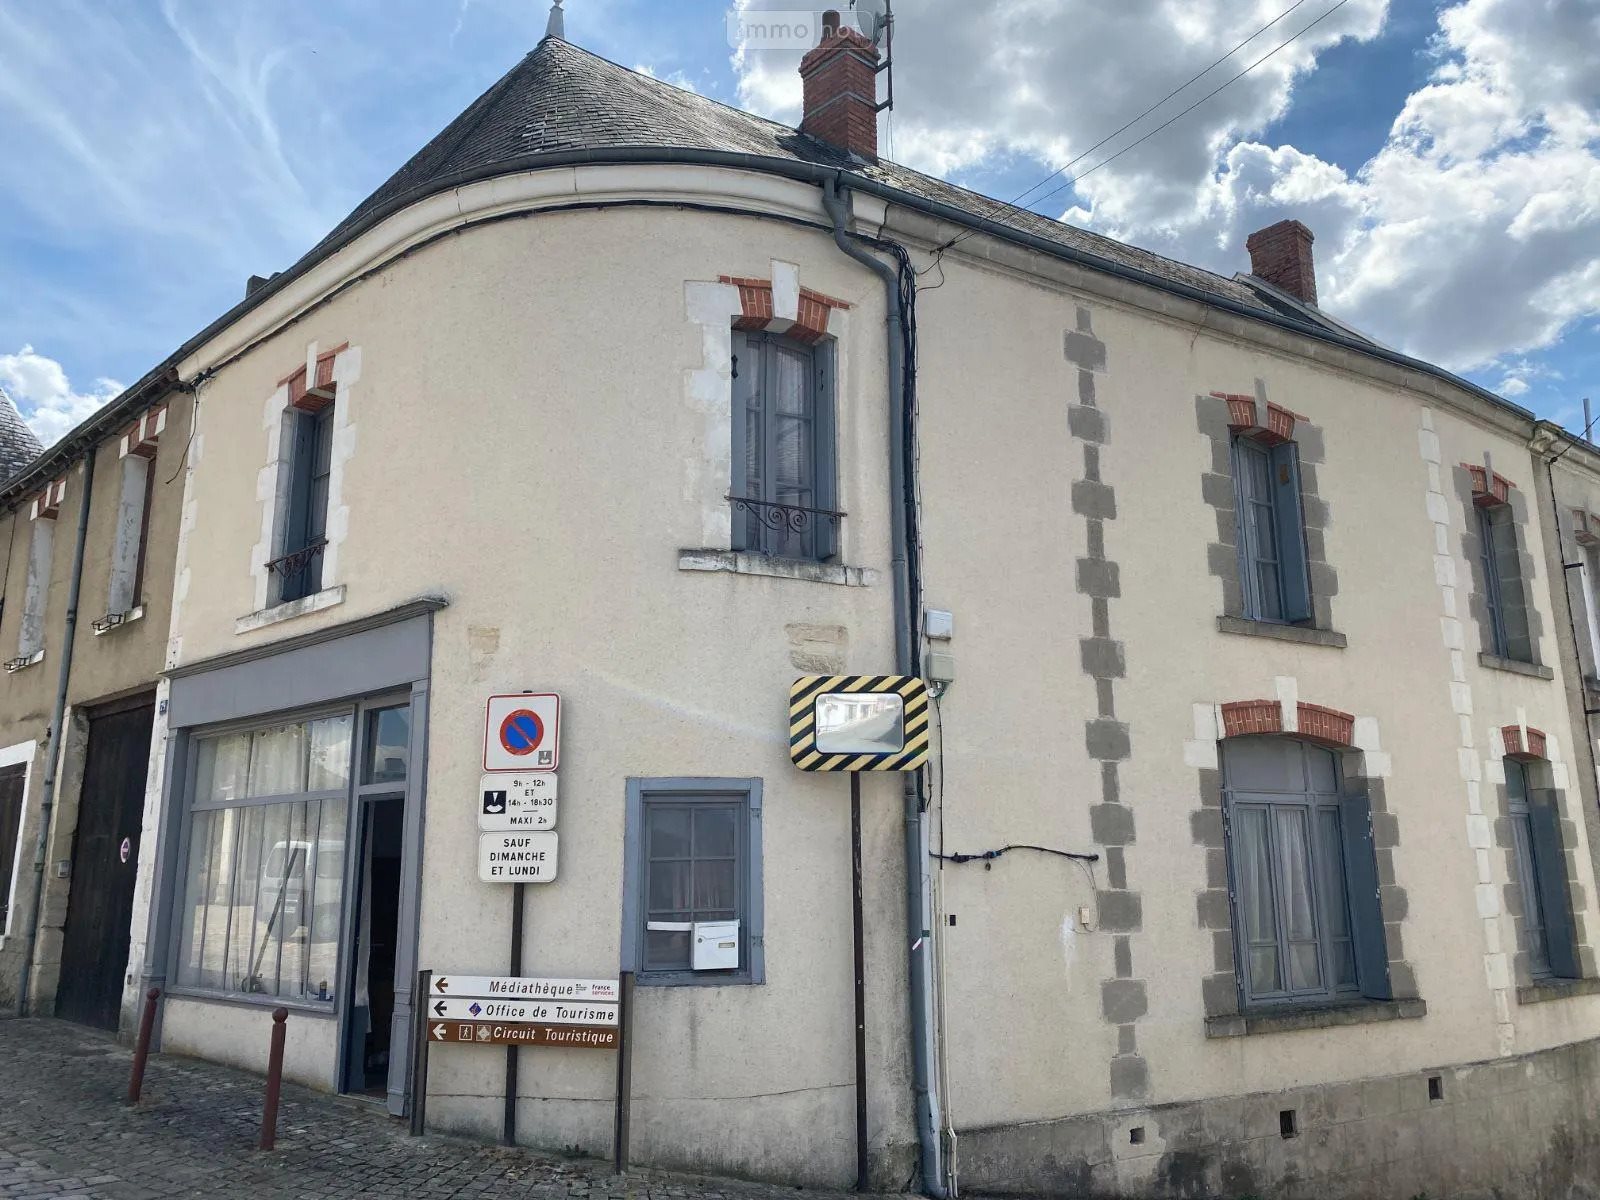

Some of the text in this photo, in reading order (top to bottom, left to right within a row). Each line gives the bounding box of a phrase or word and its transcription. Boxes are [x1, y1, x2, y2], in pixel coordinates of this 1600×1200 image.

[513, 779, 522, 787] 9h
[532, 779, 546, 787] 12h
[530, 798, 553, 806] 18h30
[510, 816, 547, 825] MAXI 2h
[503, 838, 531, 848] SAUF
[490, 852, 546, 861] DIMANCHE
[491, 866, 540, 875] ET LUNDI
[489, 981, 573, 998] Médiathèque
[486, 1004, 614, 1020] Office de Tourisme
[493, 1026, 613, 1045] Circuit Touristique
